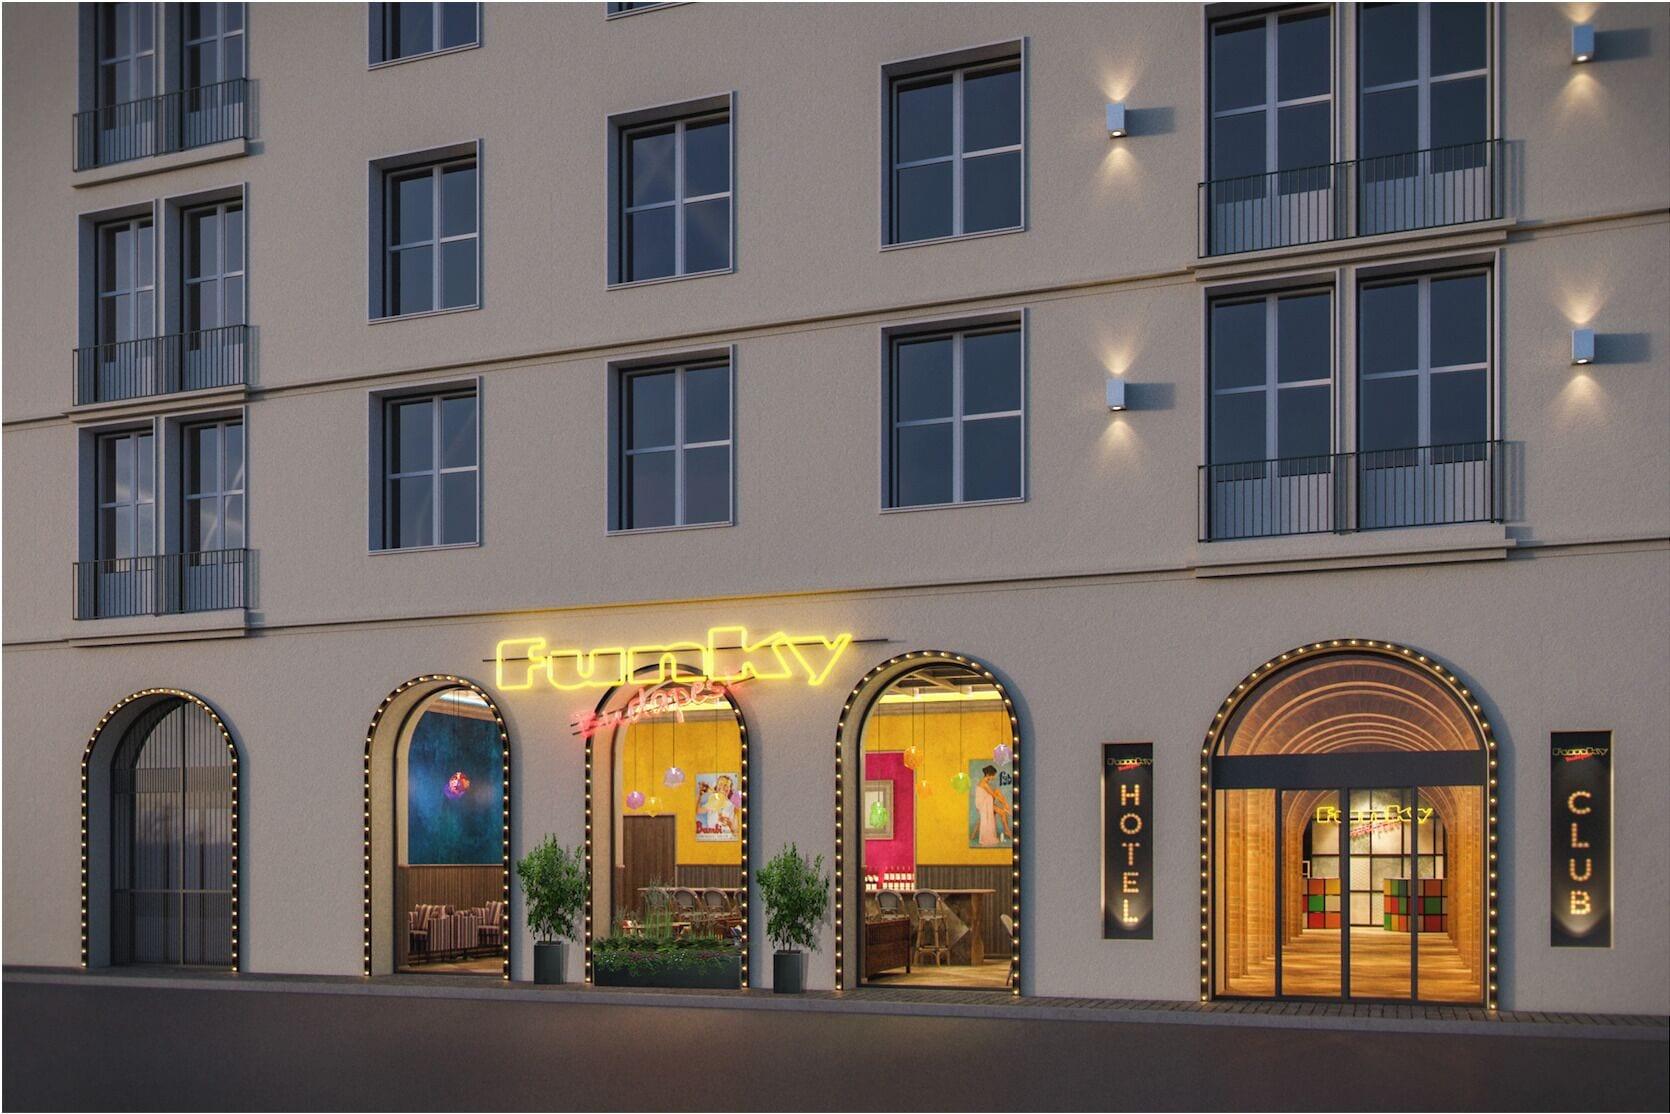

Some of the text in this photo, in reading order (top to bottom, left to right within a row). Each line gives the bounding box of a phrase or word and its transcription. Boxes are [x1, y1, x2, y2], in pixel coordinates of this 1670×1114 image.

[496, 626, 853, 690] Funky
[1120, 784, 1142, 923] HOTEL
[1568, 791, 1592, 915] CLUB
